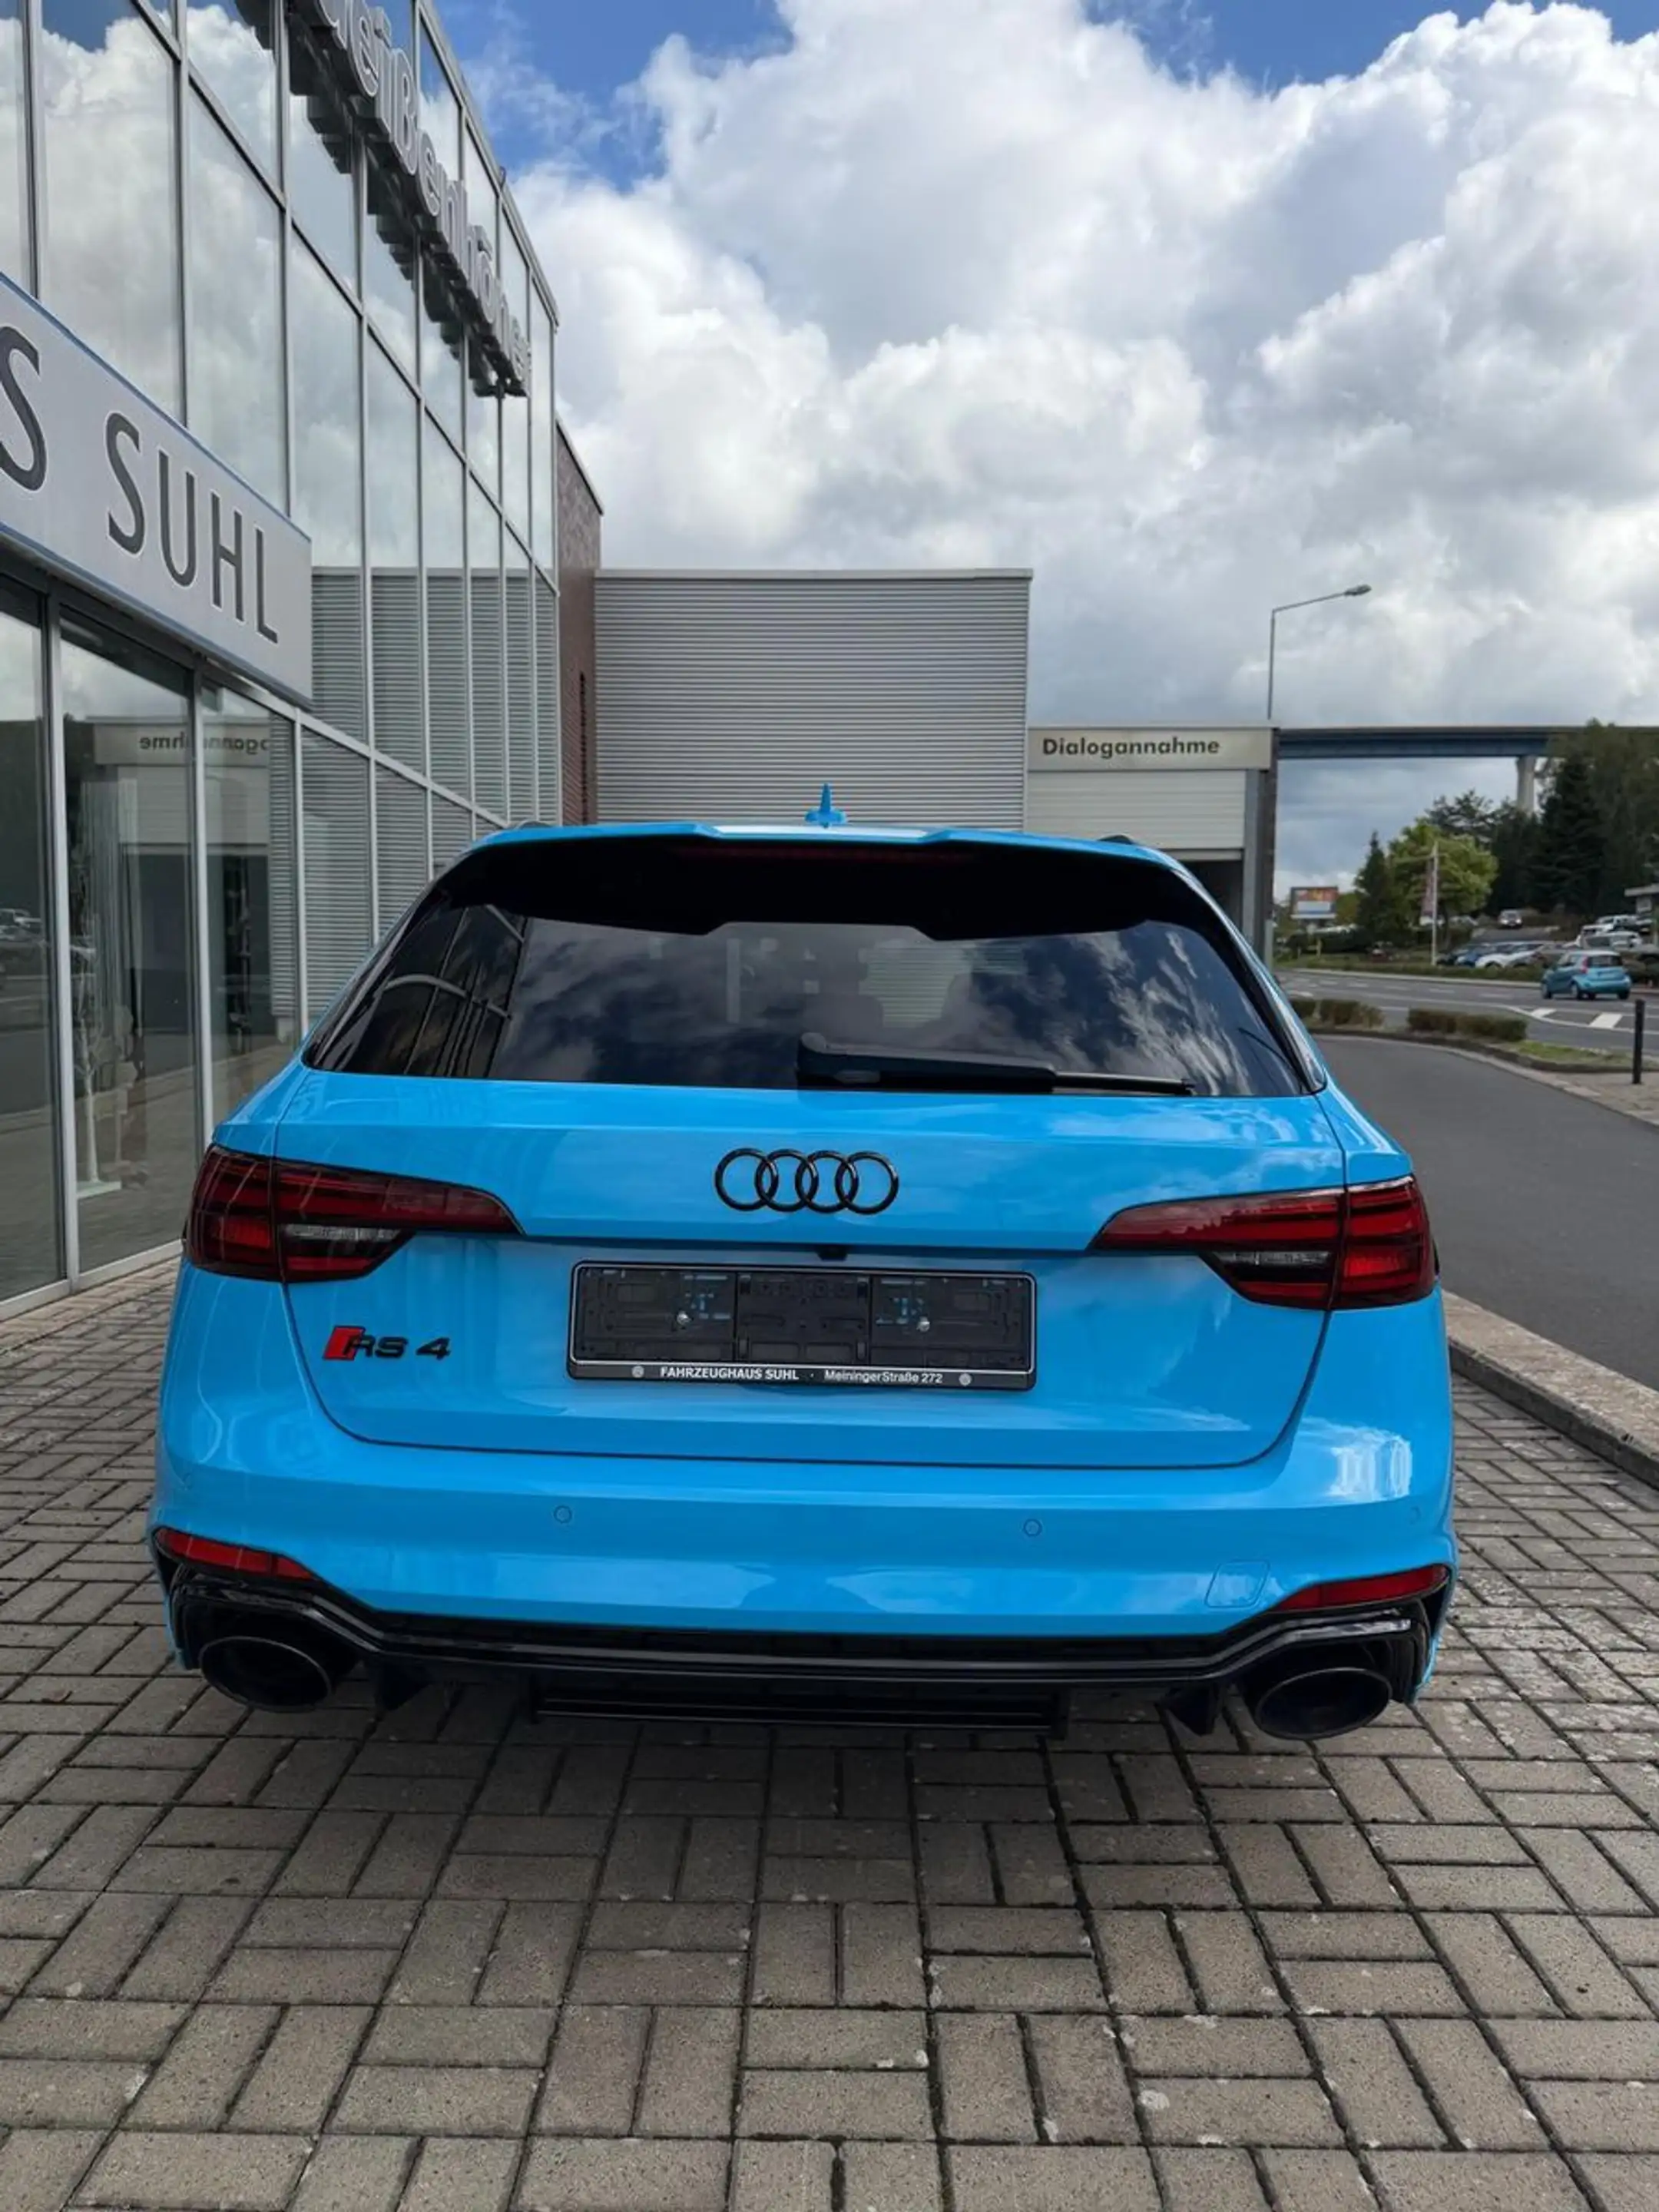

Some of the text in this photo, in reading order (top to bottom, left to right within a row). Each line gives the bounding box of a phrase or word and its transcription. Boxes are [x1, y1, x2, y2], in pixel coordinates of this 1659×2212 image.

[107, 412, 278, 644] SUHL
[1042, 736, 1220, 760] Dialogannahme
[339, 1332, 452, 1360] RS 4
[660, 1366, 762, 1379] FAHRZEUGHAUS
[765, 1367, 800, 1380] SUHL
[921, 1373, 943, 1384] 272
